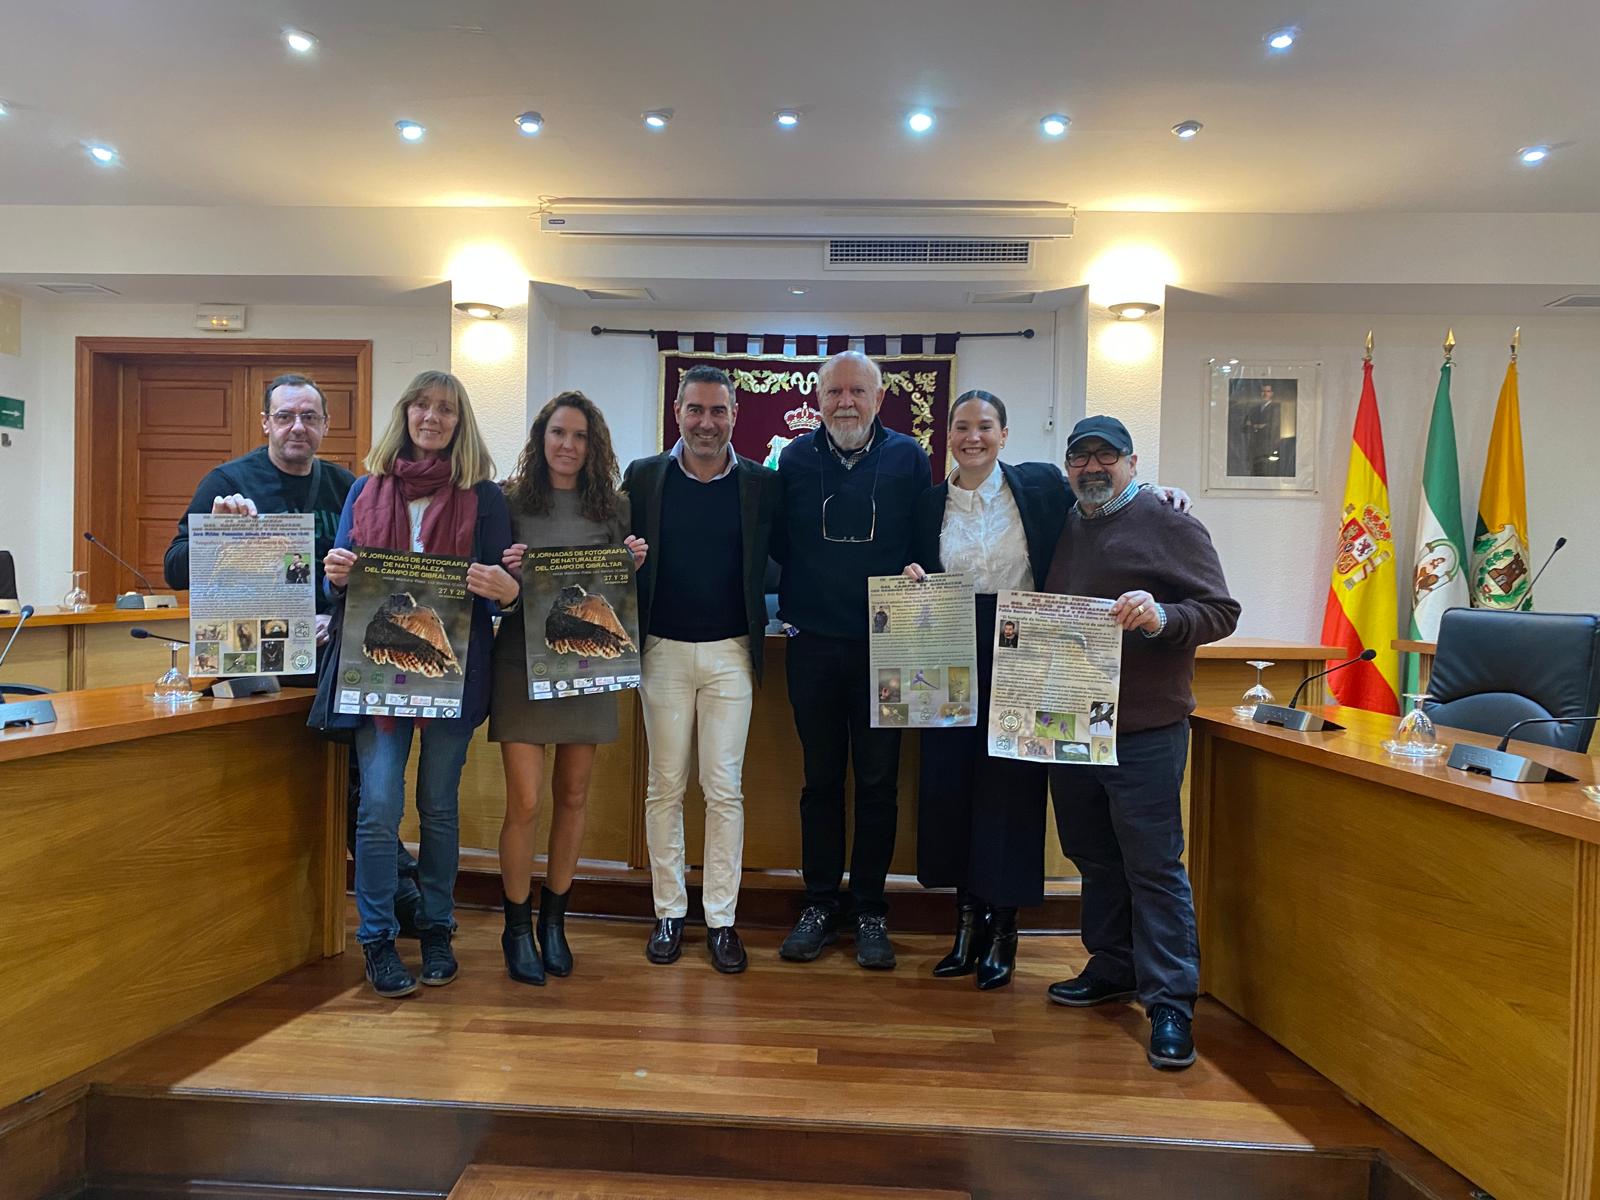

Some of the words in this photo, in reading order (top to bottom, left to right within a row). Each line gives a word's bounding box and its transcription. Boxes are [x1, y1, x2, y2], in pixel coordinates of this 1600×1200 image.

[368, 552, 410, 562] JORNADAS
[536, 550, 573, 558] JORNADAS
[561, 556, 606, 564] NATURALEZA
[394, 562, 444, 572] NATURALEZA
[586, 561, 622, 569] GIBRALTAR
[381, 568, 408, 576] CAMPO
[421, 572, 461, 580] GIBRALTAR
